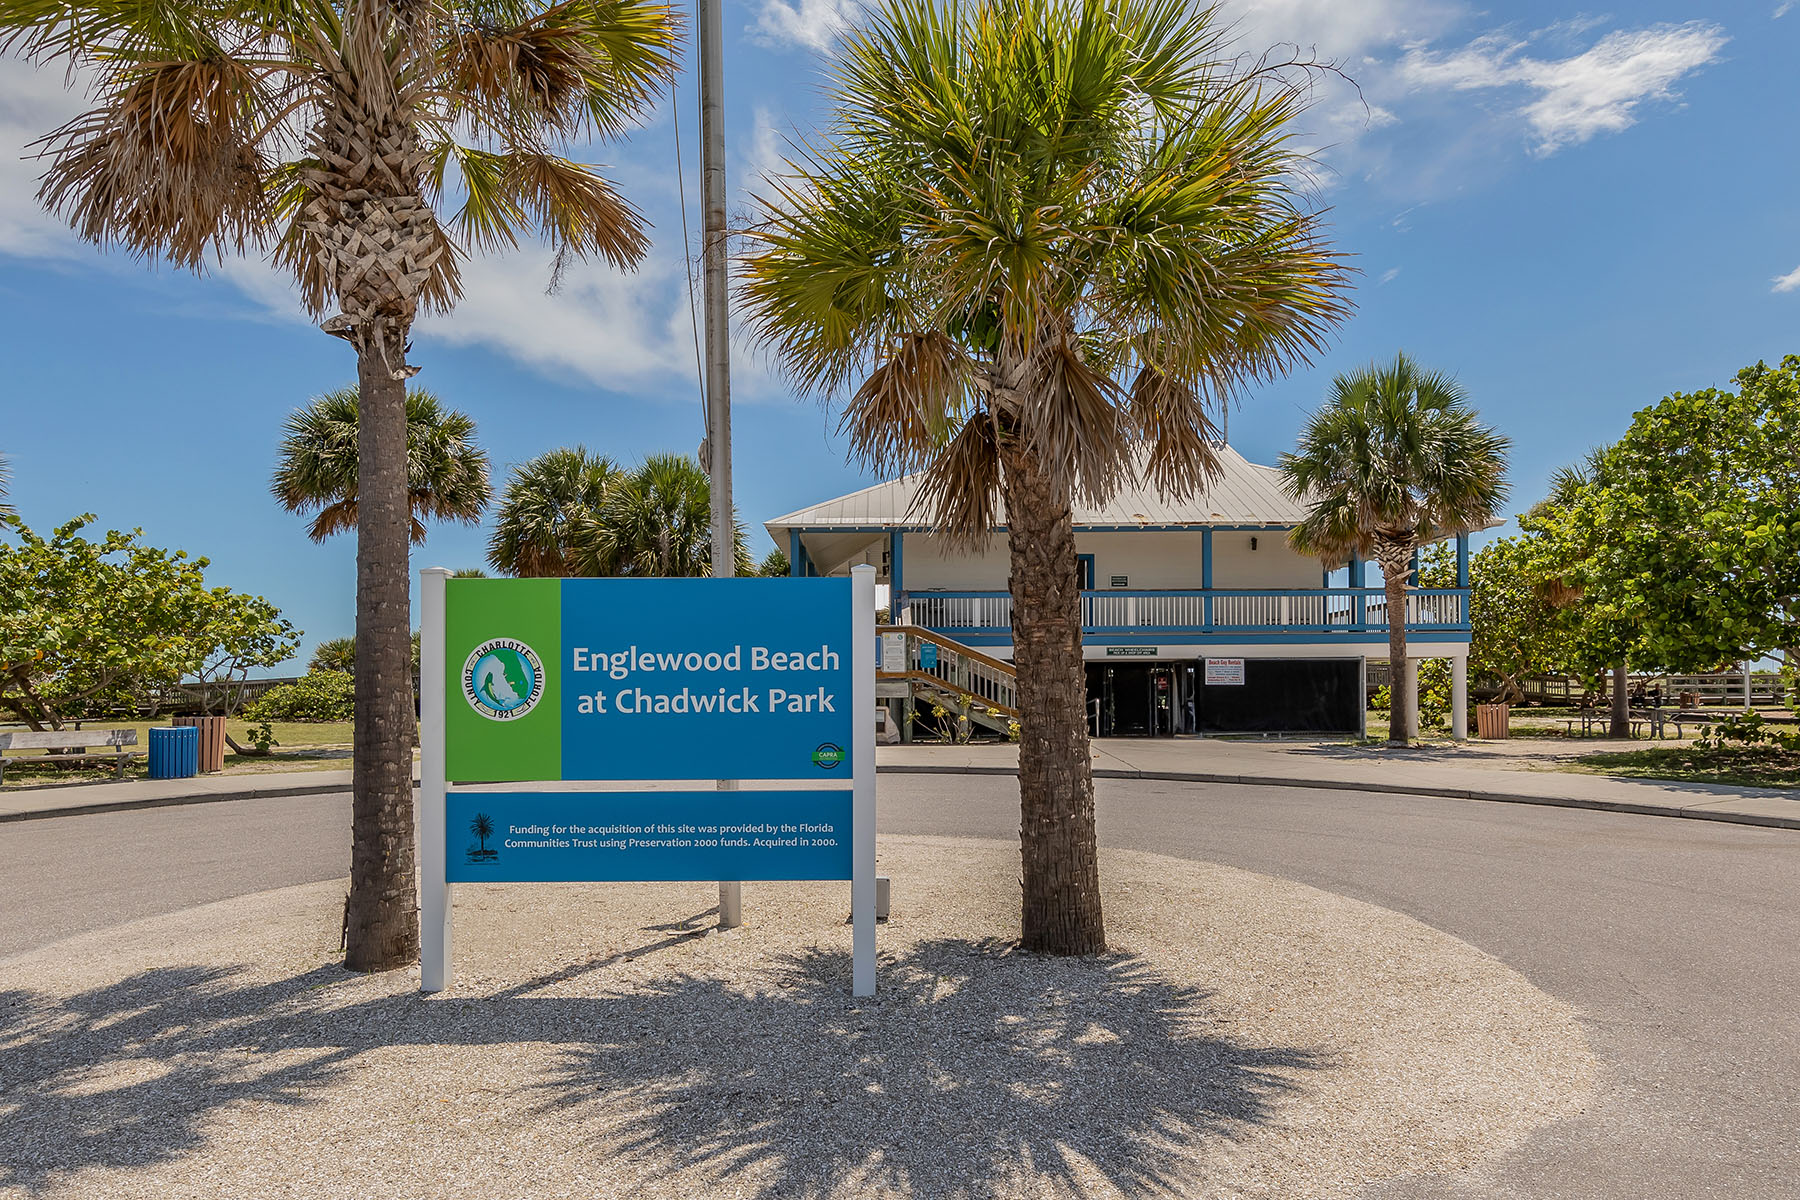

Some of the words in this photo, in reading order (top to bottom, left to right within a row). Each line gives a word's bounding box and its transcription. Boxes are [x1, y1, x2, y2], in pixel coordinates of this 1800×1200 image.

[476, 641, 532, 658] CHARLOTTE
[573, 645, 741, 680] Englewood
[751, 644, 840, 671] Beach
[465, 669, 481, 706] COUNTY
[526, 665, 542, 708] FLORIDA
[577, 690, 607, 714] at
[615, 687, 760, 714] Chadwick
[769, 686, 836, 713] Park
[493, 710, 514, 719] 1921
[509, 824, 549, 836] Funding
[552, 824, 567, 834] for
[569, 824, 586, 834] the
[588, 824, 641, 836] acquisition
[643, 823, 655, 834] of
[656, 823, 676, 834] this
[677, 824, 696, 834] site
[697, 825, 718, 833] was
[719, 823, 764, 836] provided
[766, 823, 779, 836] by
[780, 823, 797, 833] the
[799, 823, 834, 833] Florida
[504, 838, 569, 848] Communities
[572, 838, 598, 848] Trust
[599, 838, 627, 850] using
[628, 837, 692, 848] Preservation
[694, 839, 718, 847] 2000
[720, 837, 751, 847] funds.
[752, 837, 798, 849] Acquired
[799, 837, 809, 846] in
[811, 838, 838, 847] 2000.
